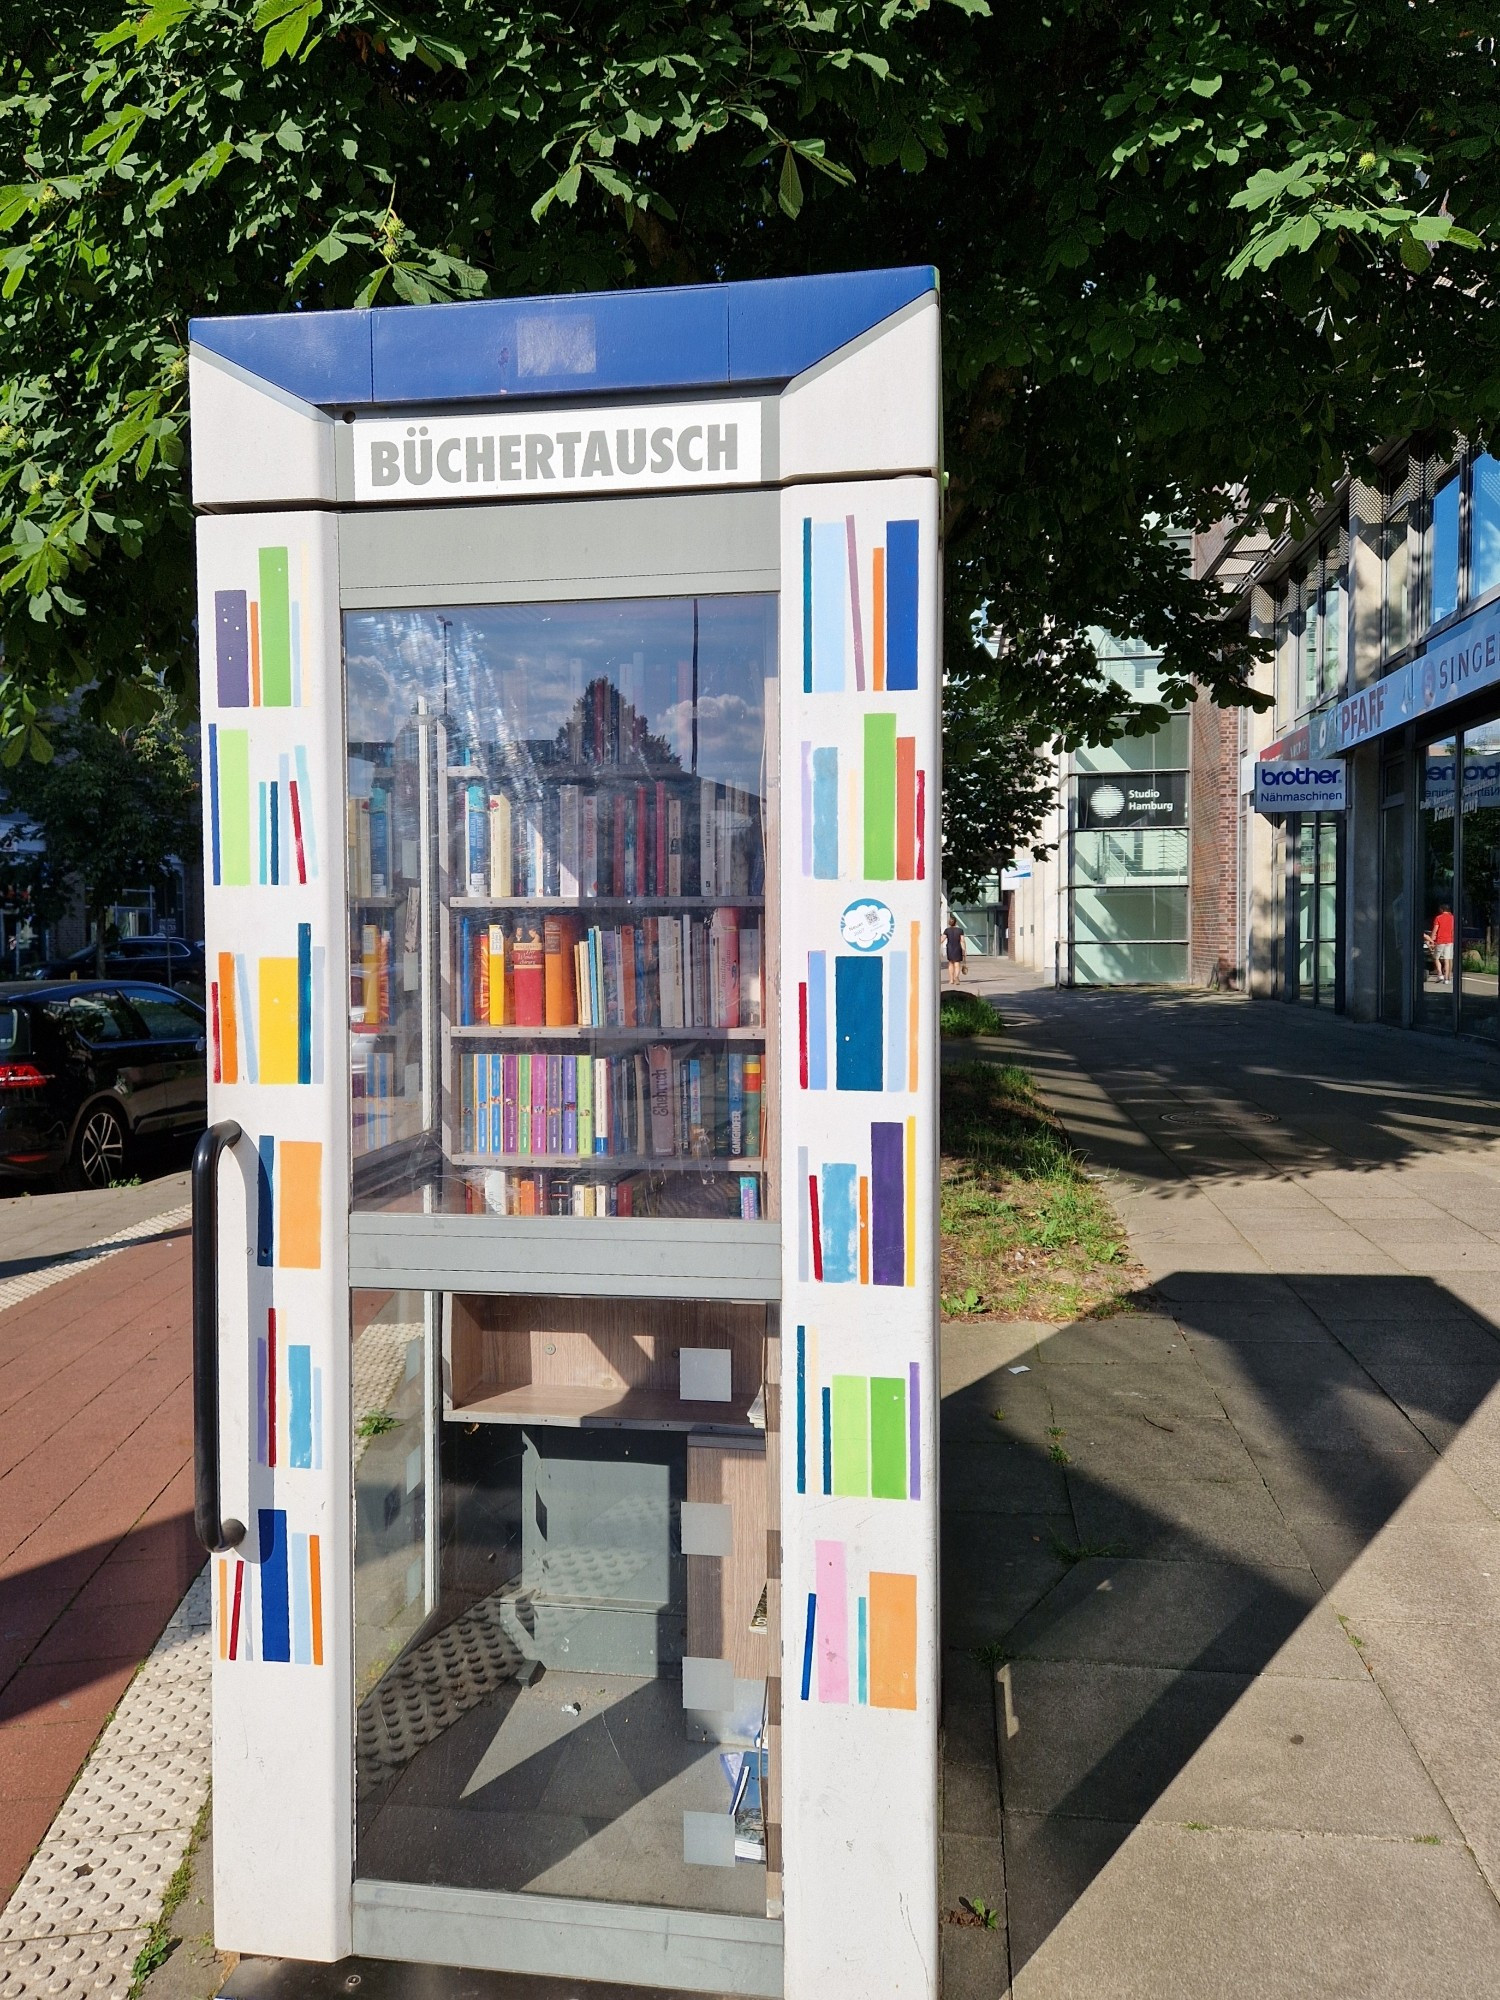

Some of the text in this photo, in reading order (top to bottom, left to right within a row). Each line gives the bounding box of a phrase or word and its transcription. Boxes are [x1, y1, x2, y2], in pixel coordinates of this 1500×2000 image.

[370, 423, 738, 487] BÜCHERTAUSCH
[1439, 632, 1500, 690] SINGE
[1261, 767, 1340, 785] brother
[1128, 789, 1160, 798] Studio
[1261, 790, 1343, 802] Nähmaschinen
[1128, 802, 1174, 812] Hamburg
[732, 1111, 741, 1155] GANGHOFER
